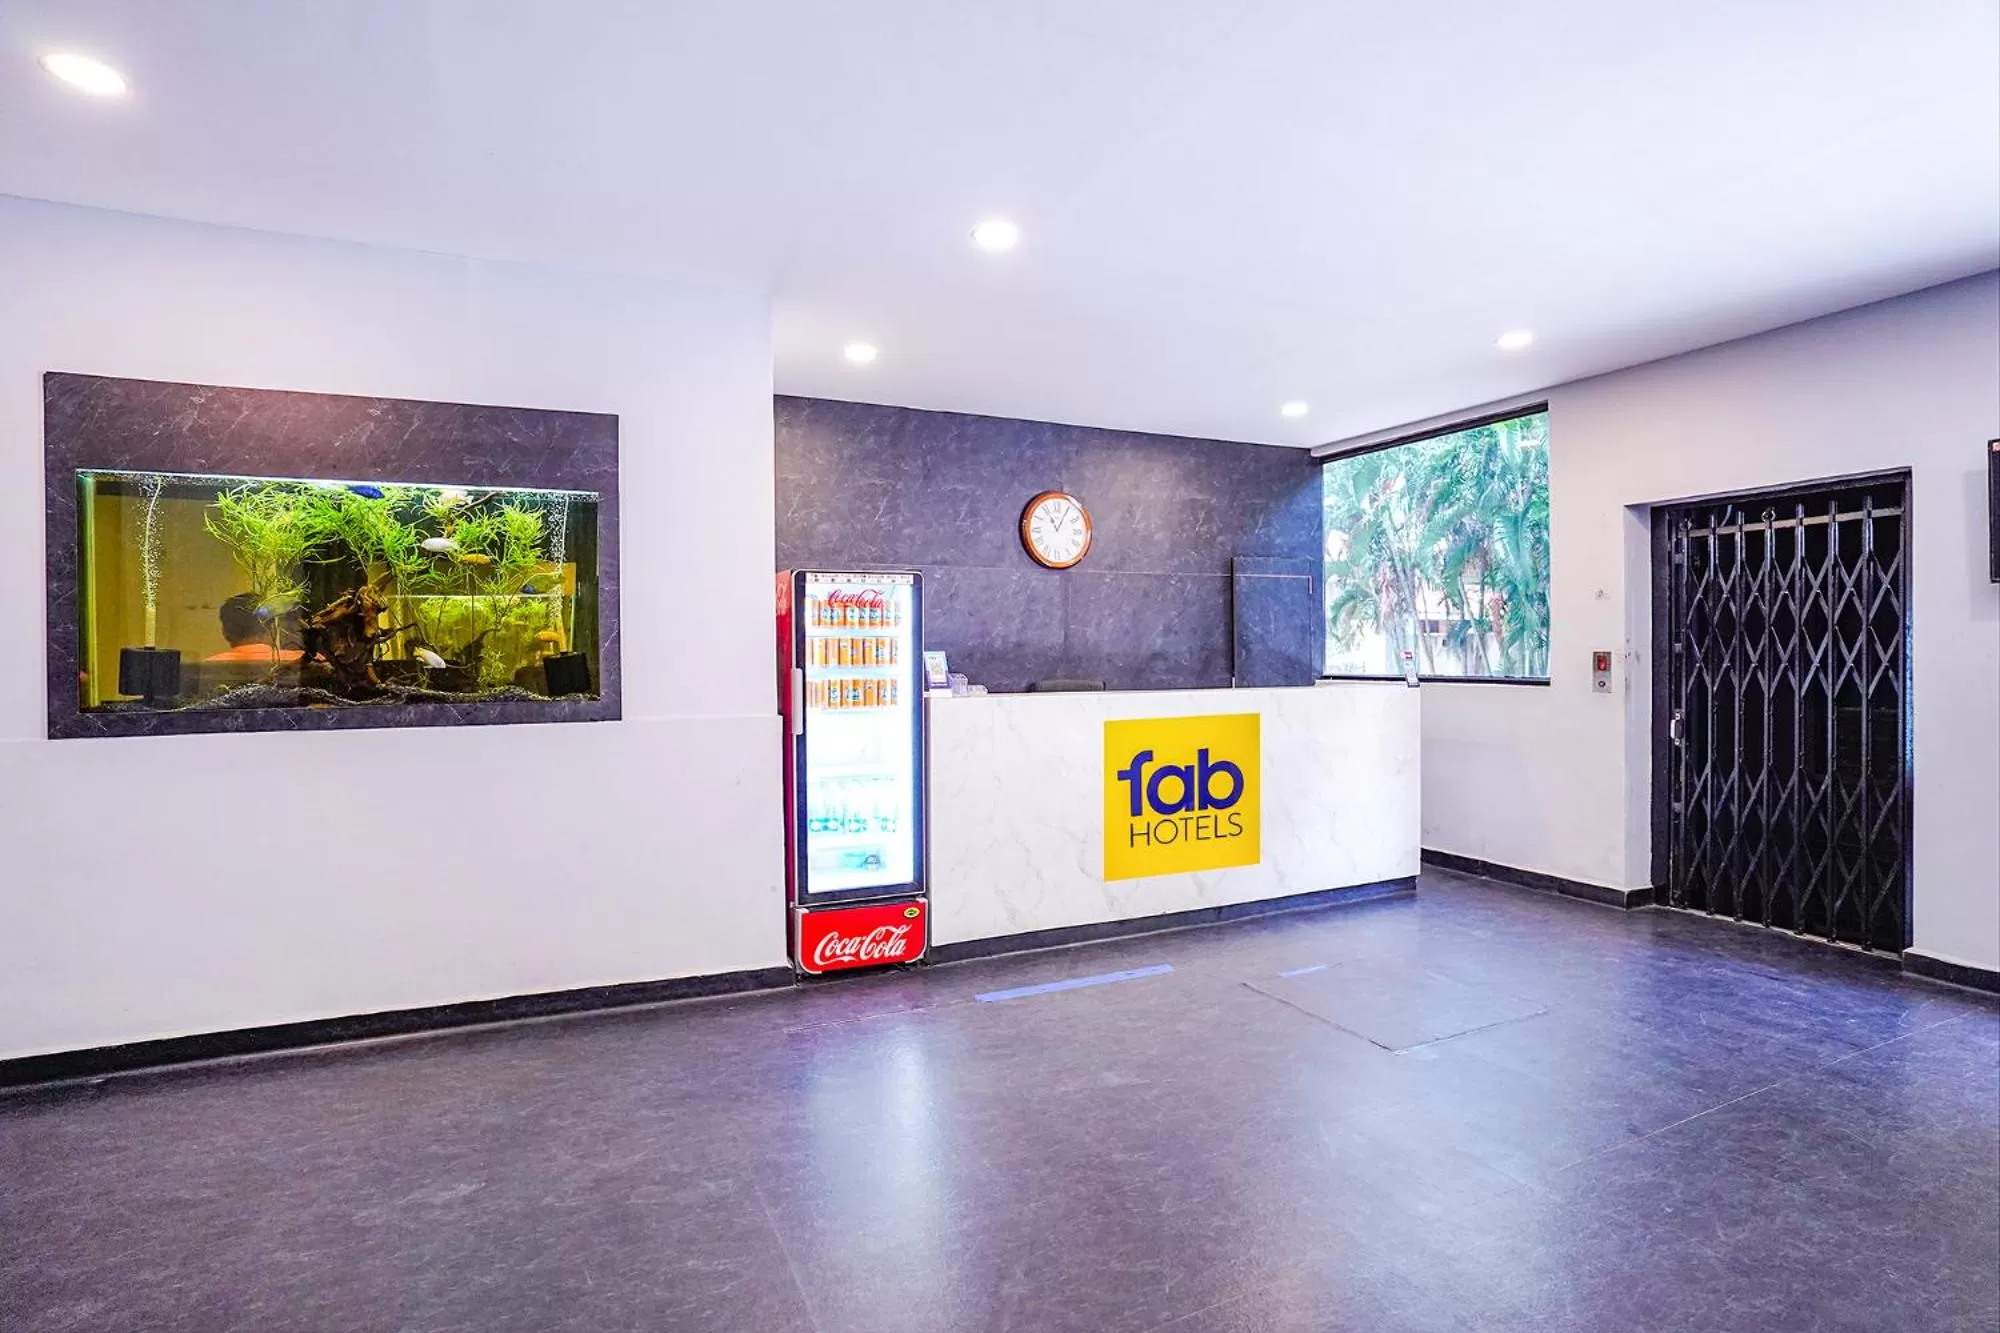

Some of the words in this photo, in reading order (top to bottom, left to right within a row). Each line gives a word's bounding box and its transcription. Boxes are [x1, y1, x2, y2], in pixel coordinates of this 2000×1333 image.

[1117, 748, 1244, 817] fab
[1130, 812, 1244, 848] HOTELS
[814, 924, 912, 966] Coca-Cola
